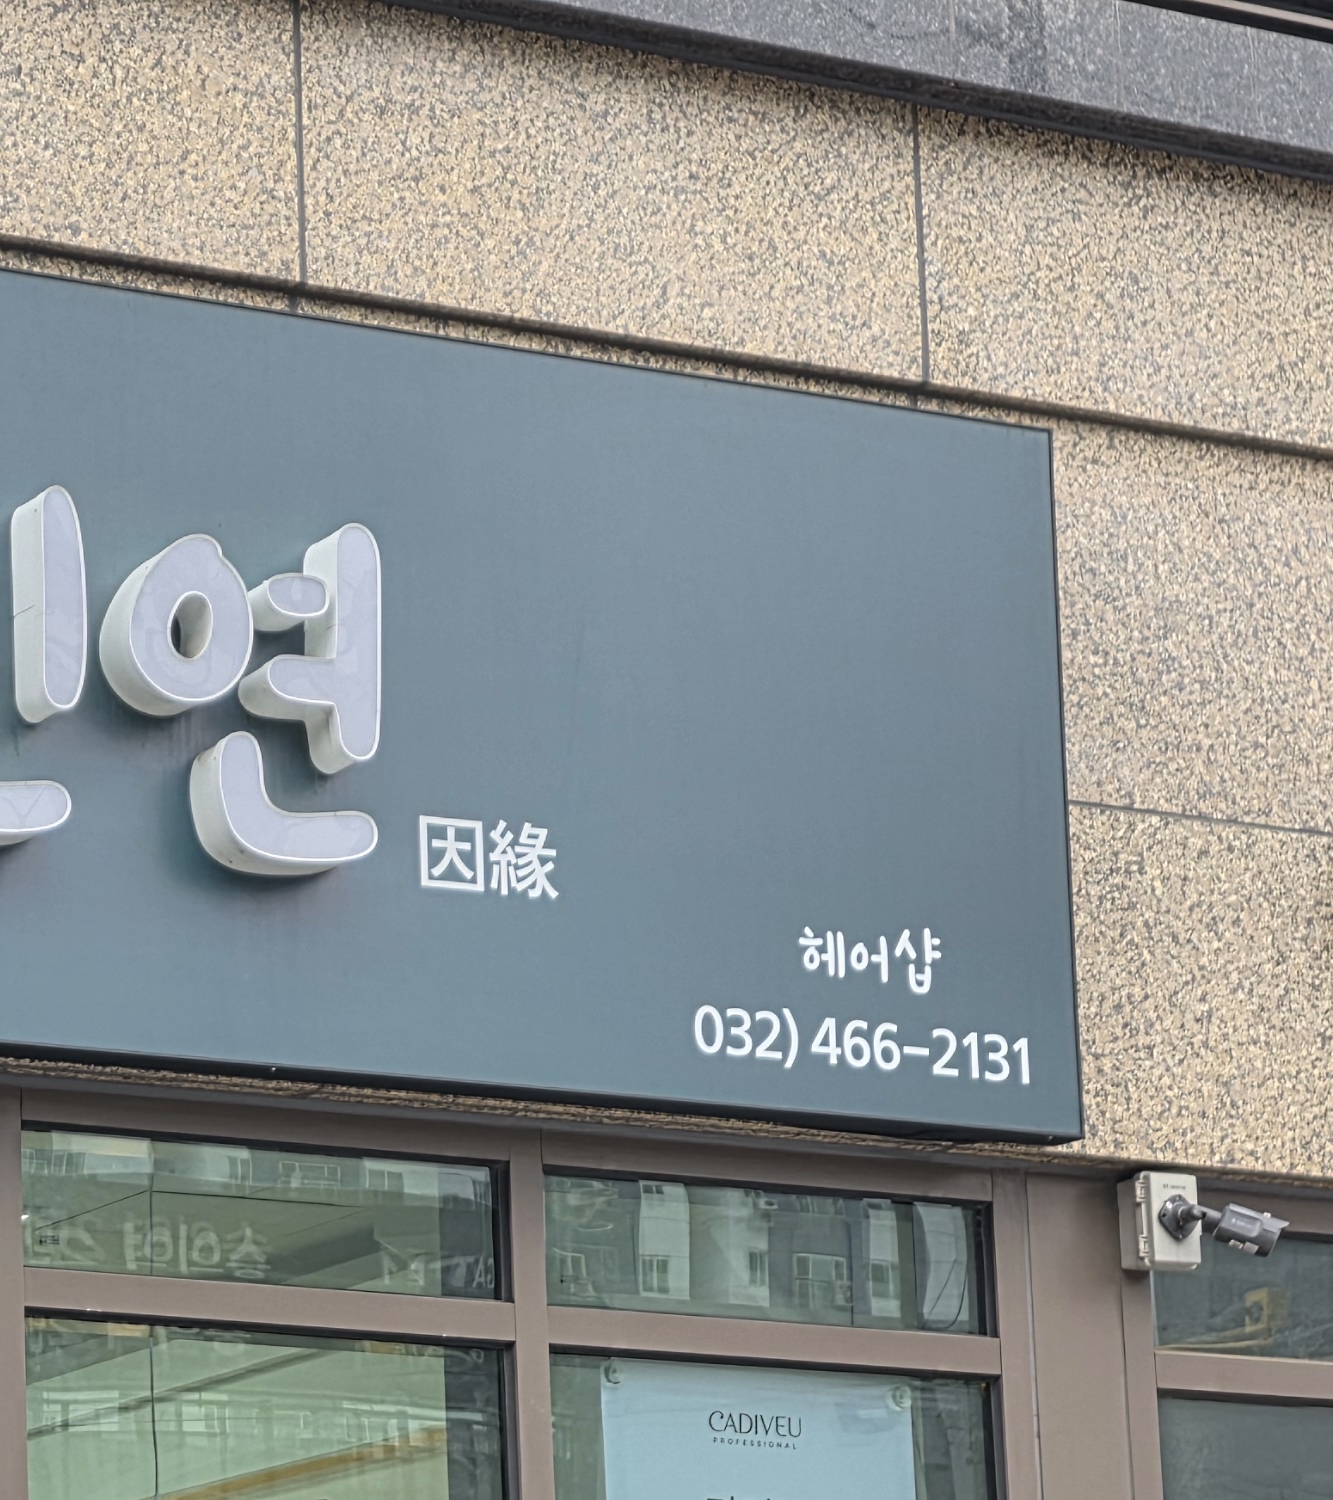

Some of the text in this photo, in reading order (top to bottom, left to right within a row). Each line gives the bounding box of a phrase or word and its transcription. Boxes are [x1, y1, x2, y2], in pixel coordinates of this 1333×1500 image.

[798, 925, 942, 994] 헤어샵
[693, 1004, 1031, 1085] 032) 466-2131
[708, 1410, 803, 1438] CADIVEU
[712, 1437, 797, 1450] PROFESSIONAL
